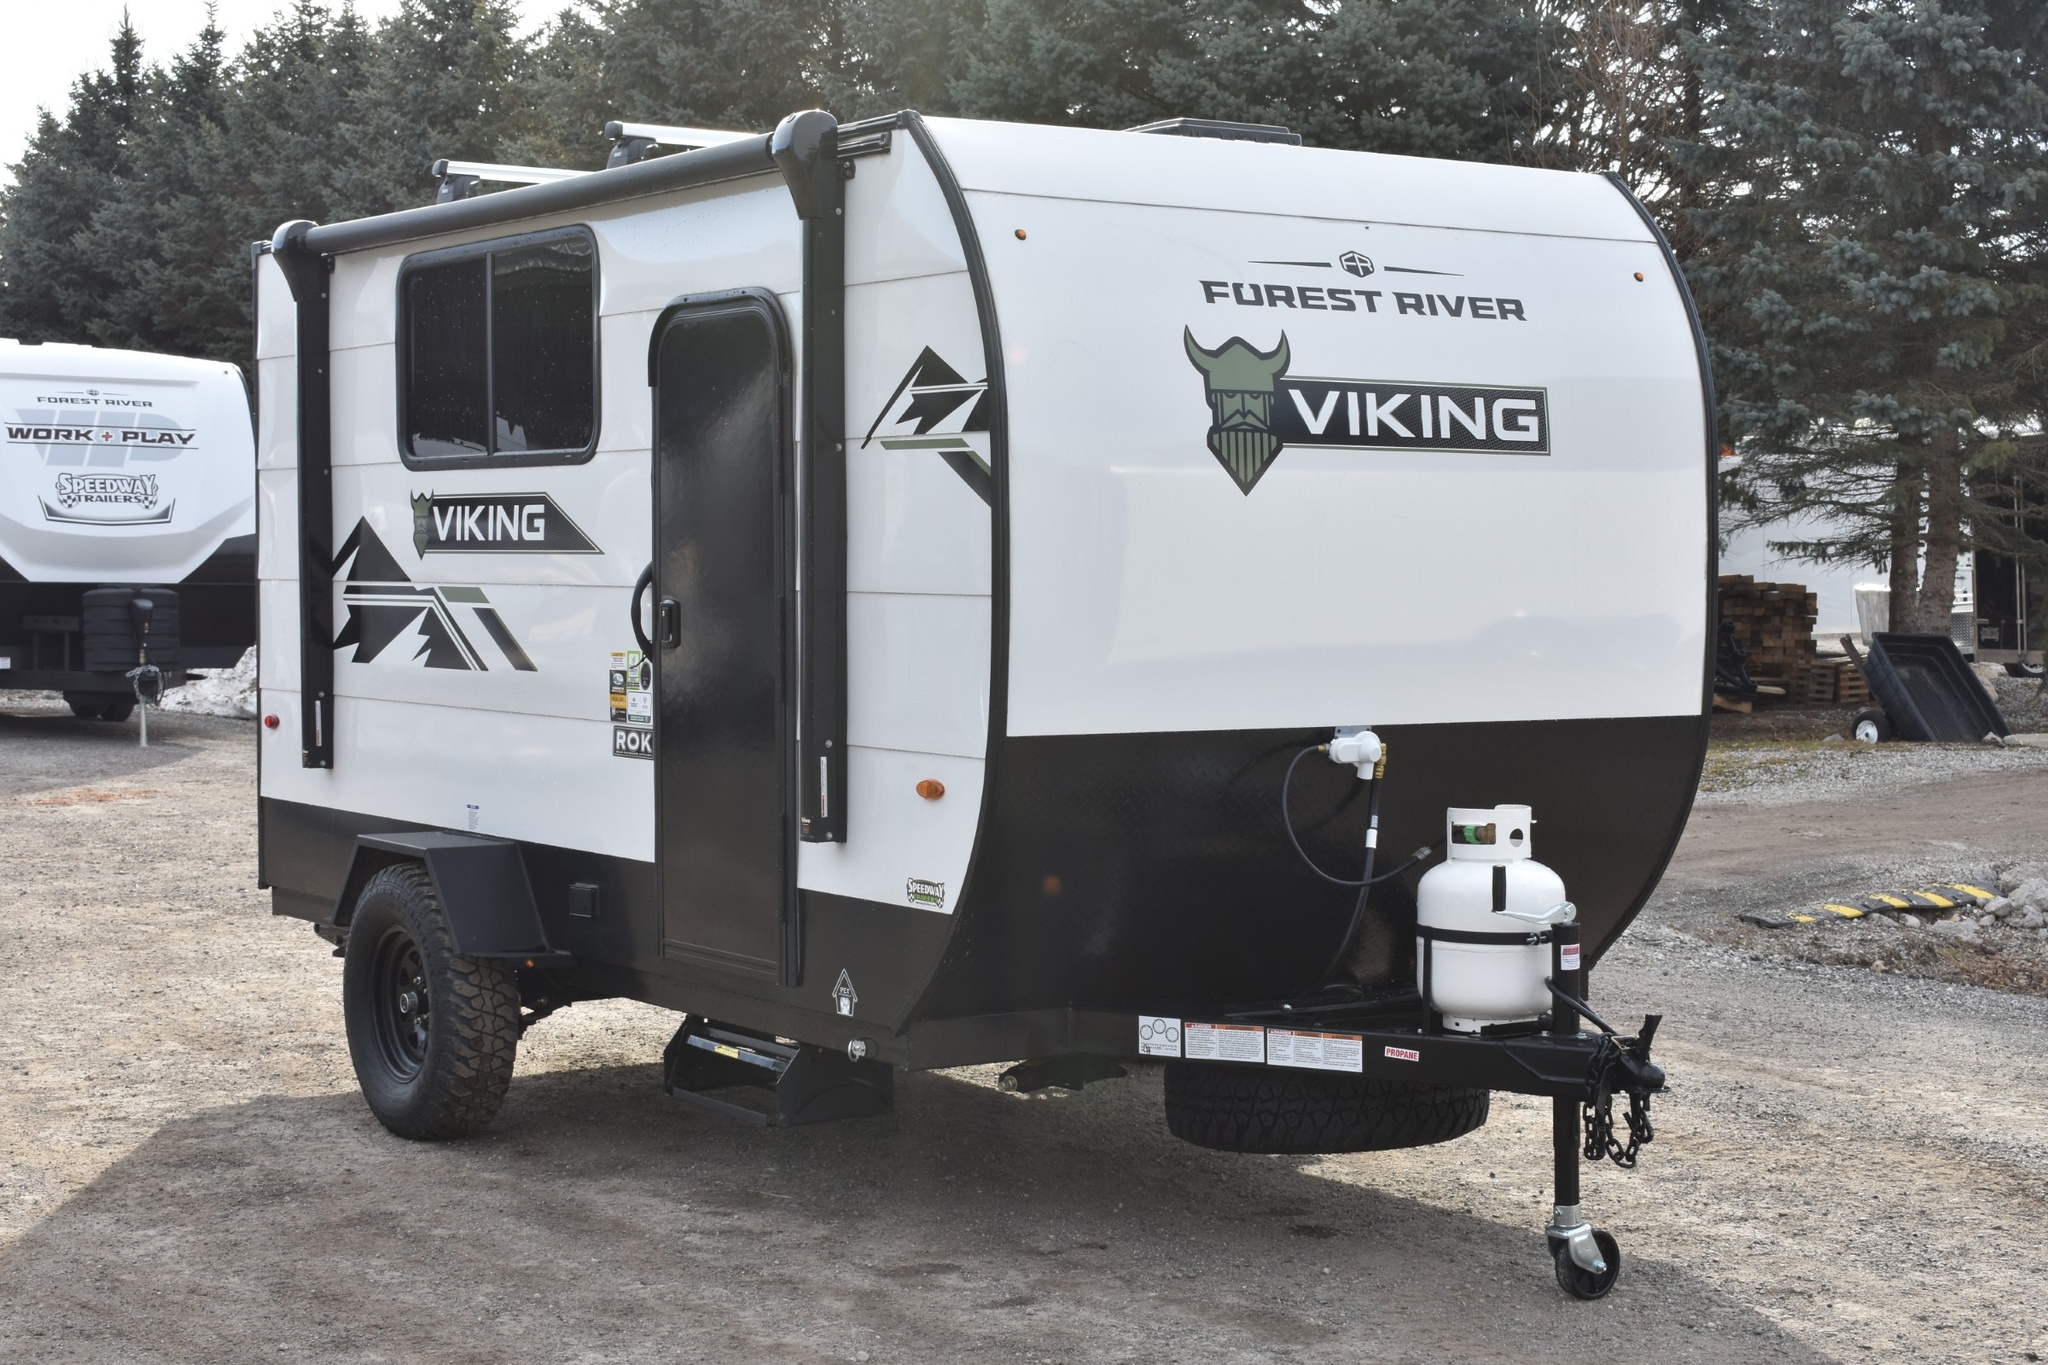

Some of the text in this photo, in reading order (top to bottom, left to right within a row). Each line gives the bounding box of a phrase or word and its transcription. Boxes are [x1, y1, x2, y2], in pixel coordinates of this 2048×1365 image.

[1198, 280, 1528, 321] FOREST RIVER
[37, 396, 154, 408] FOREST RIVER
[1287, 388, 1540, 442] VIKING
[7, 427, 94, 442] WORK
[121, 430, 196, 445] PLAY
[57, 473, 157, 496] SPEEDWAY
[77, 494, 142, 504] TRAILERS
[433, 504, 545, 541] VIKING
[616, 730, 652, 753] ROK
[907, 877, 945, 898] SPEEDWAY
[839, 986, 850, 995] PET
[1386, 1048, 1418, 1060] PROPANE
